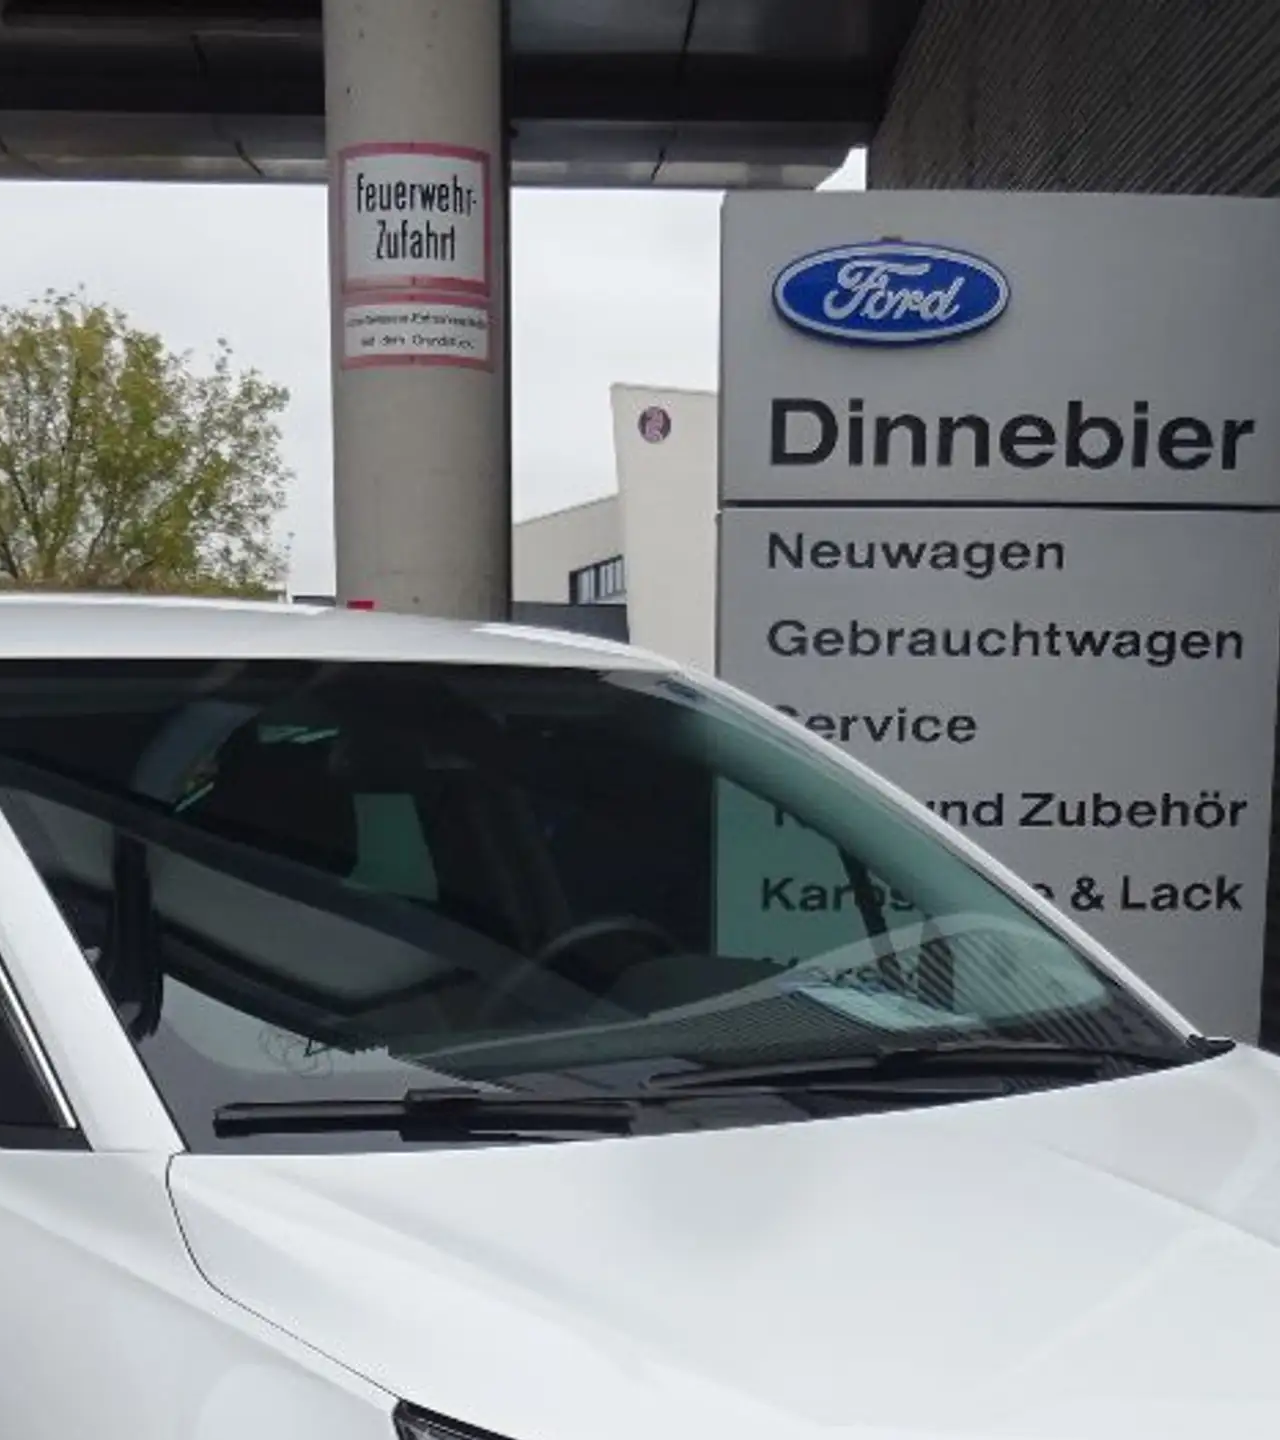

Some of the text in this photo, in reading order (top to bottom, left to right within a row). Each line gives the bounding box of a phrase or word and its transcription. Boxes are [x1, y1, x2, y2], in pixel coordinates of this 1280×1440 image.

[356, 172, 478, 217] Feuerwehr-
[375, 219, 457, 262] Zufahrt
[822, 258, 966, 322] Ford
[770, 397, 1256, 471] Dinnebier
[767, 532, 1065, 580] Neuwagen
[766, 619, 1245, 668] Gebrauchtwagen
[925, 790, 1249, 830] nd Zubehör
[1069, 876, 1106, 913] &
[1120, 875, 1244, 913] Lack
